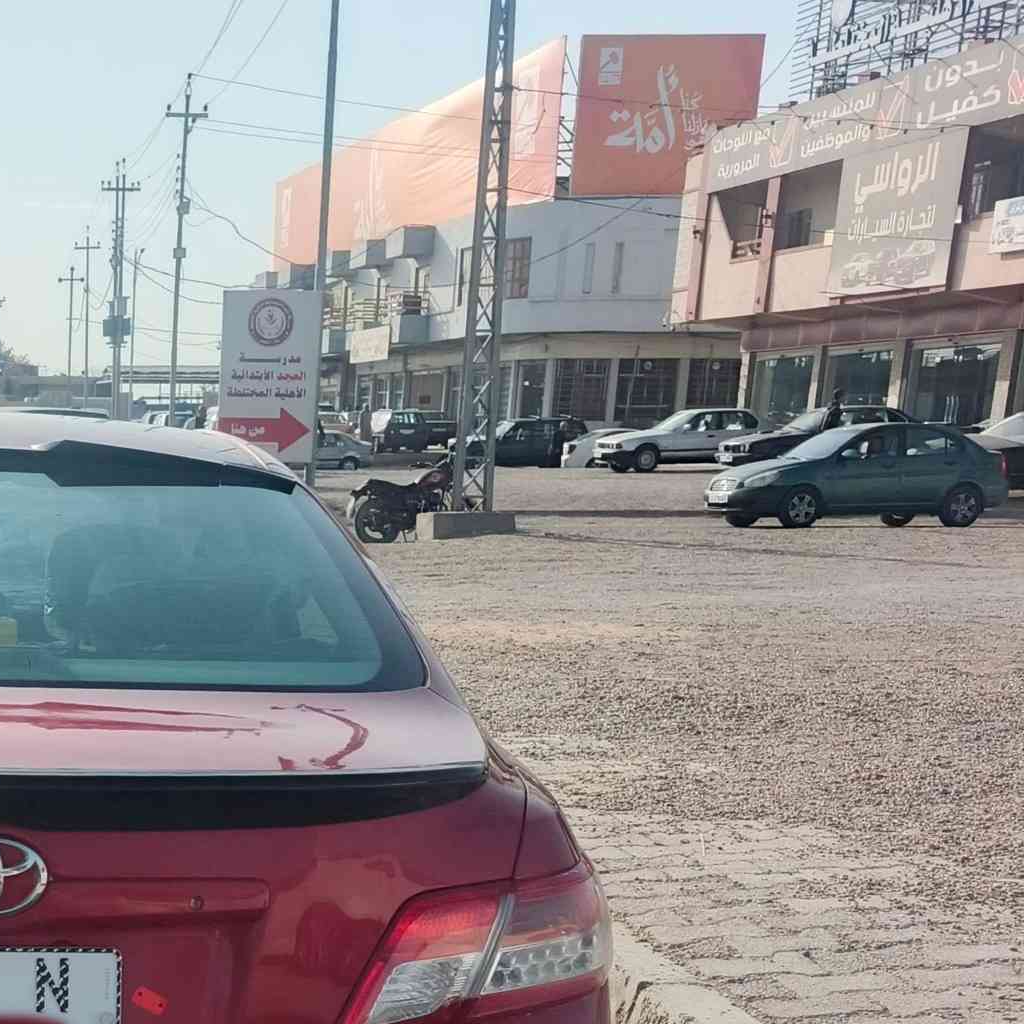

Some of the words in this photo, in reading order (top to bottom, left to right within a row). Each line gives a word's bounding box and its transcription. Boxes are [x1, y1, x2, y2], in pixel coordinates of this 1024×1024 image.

[916, 84, 1001, 130] كفيل
[800, 123, 871, 158] والموظفين
[717, 152, 761, 178] المرورية
[854, 142, 941, 213] الرواسي
[847, 211, 897, 243] السيارات
[897, 204, 937, 237] لتجارة
[35, 958, 70, 1013] N
